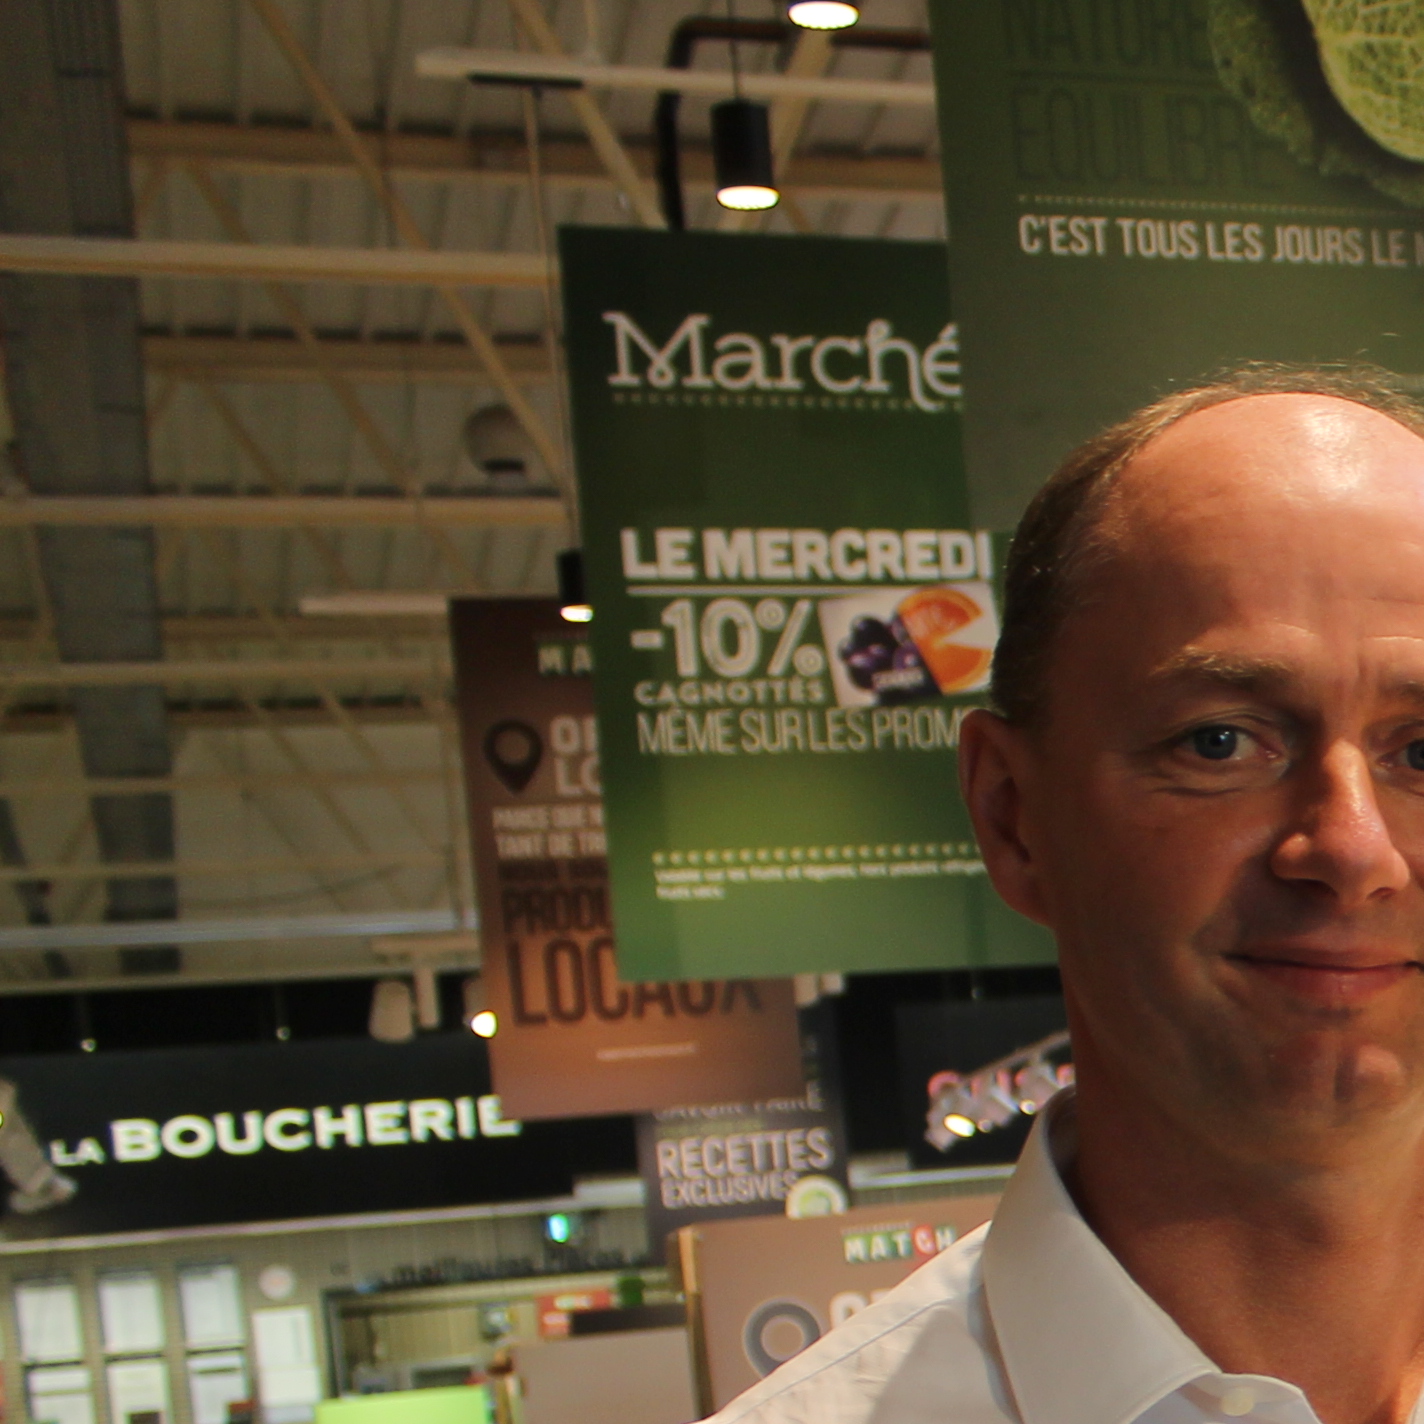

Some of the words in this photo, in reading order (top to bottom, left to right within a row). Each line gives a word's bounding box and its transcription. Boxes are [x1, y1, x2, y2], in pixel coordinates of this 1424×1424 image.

[1018, 214, 1105, 256] C'EST
[1116, 218, 1198, 261] TOUS
[1206, 221, 1263, 263] LES
[1271, 224, 1365, 266] JOURS
[1372, 228, 1409, 268] LE
[602, 309, 961, 412] Marché
[620, 527, 697, 581] LE
[701, 527, 992, 581] MERCREDI
[630, 597, 825, 678] -10%
[740, 710, 799, 753] SUR
[806, 709, 866, 752] LES
[871, 707, 962, 751] PROM
[49, 1136, 104, 1167] LA
[110, 1094, 521, 1164] BOUCHERIE
[656, 1126, 835, 1180] RECETTES
[844, 1224, 957, 1263] MATCH
